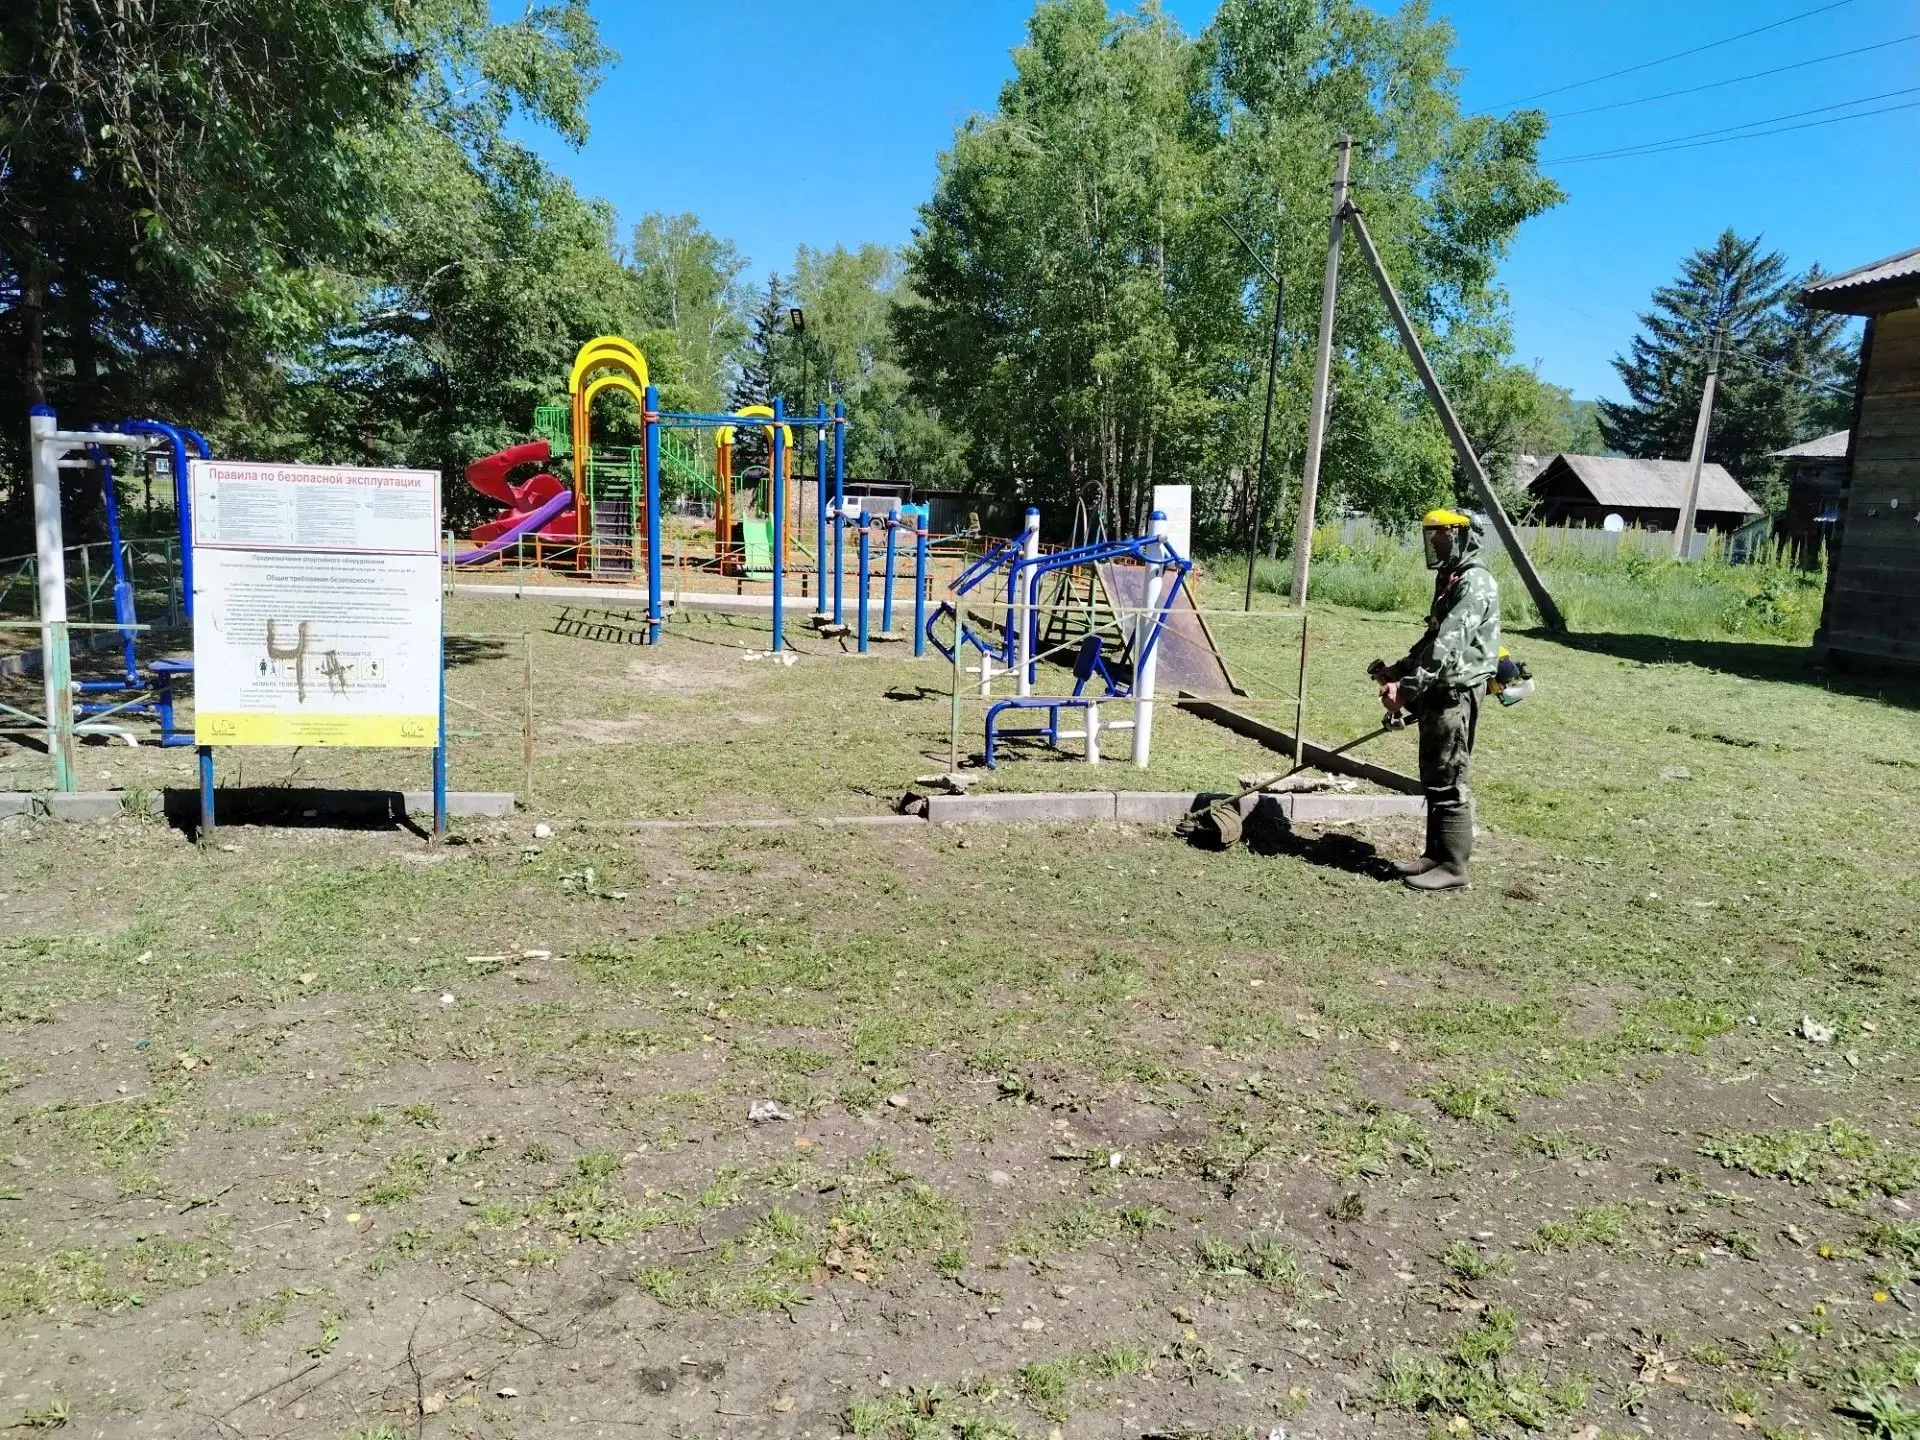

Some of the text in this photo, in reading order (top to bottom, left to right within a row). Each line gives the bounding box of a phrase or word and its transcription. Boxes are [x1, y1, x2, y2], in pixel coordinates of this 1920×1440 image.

[209, 468, 421, 489] Правила по безопасной эксплуатации
[266, 574, 375, 585] Общие требования безопасности
